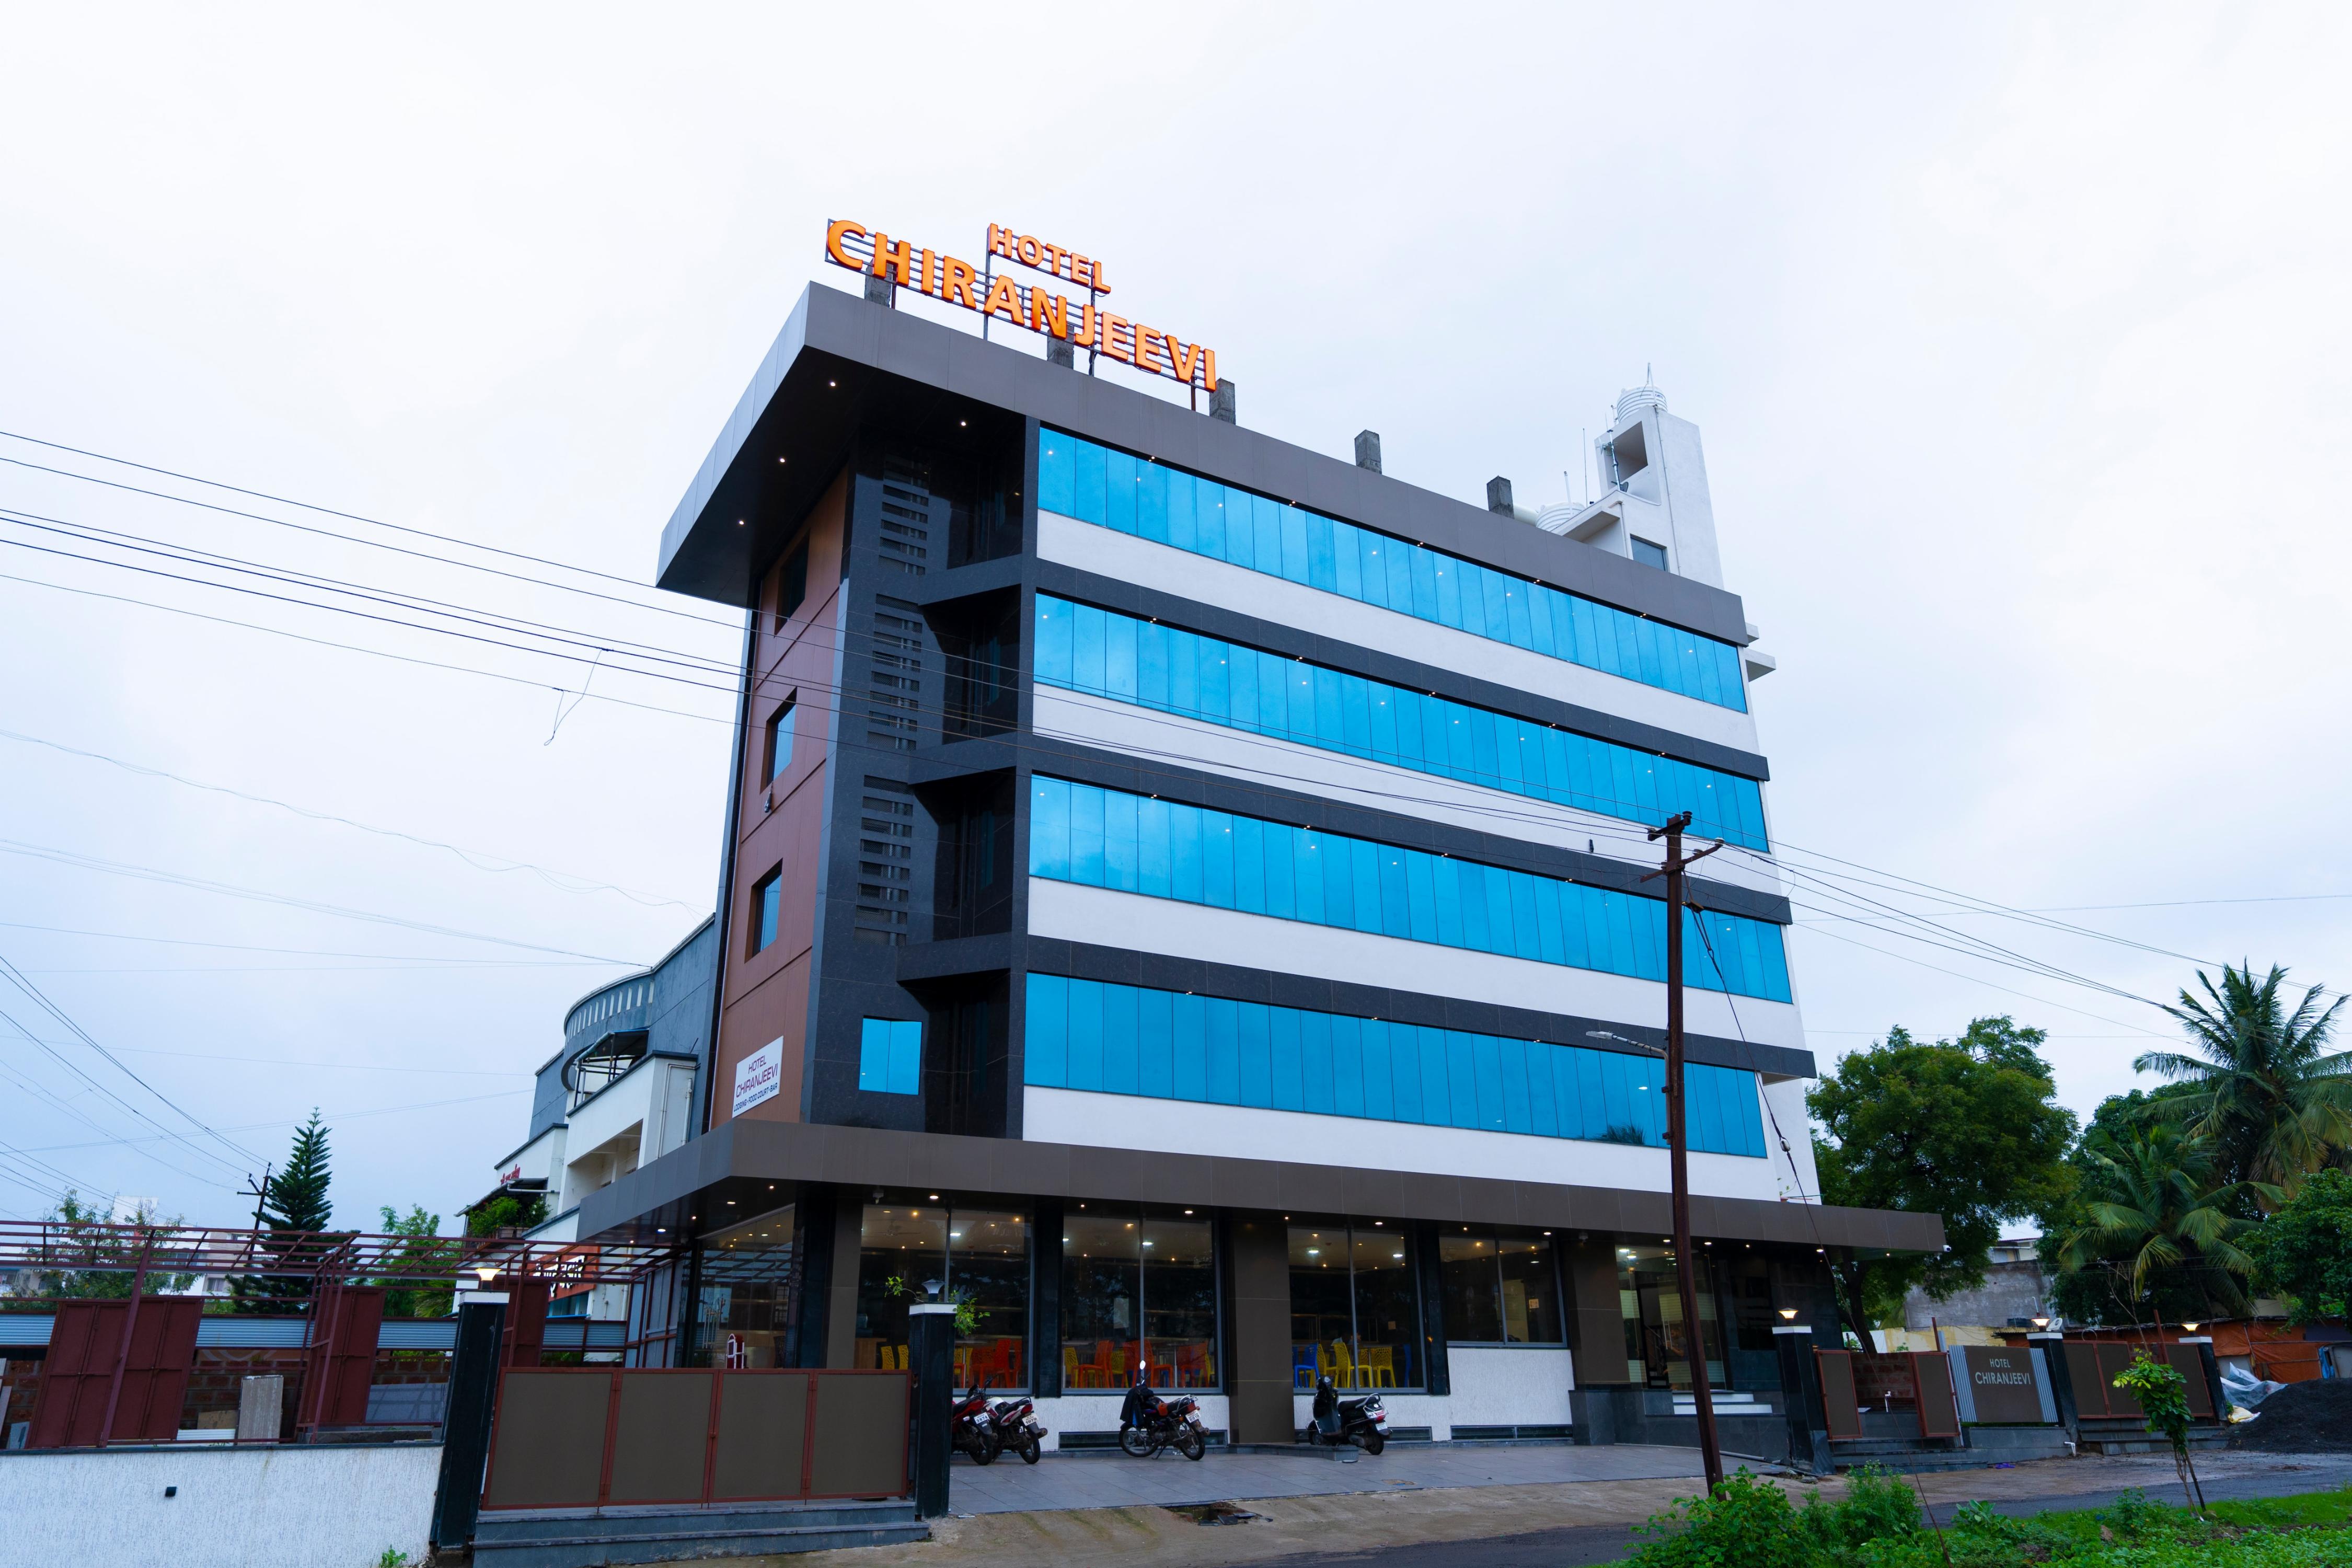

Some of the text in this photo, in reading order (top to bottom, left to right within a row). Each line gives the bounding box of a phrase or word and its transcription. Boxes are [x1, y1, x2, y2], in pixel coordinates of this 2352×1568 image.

[988, 223, 1111, 294] HOTEL
[827, 220, 1216, 393] CHIRANJEEVI
[748, 1055, 767, 1074] HOTEL
[736, 1063, 778, 1098] CHIRANJEEVI
[748, 1093, 757, 1104] FOOD
[757, 1087, 769, 1099] COURT
[1990, 1358, 2011, 1368] HOTEL
[1975, 1371, 2031, 1385] CHIRANJEEVI
